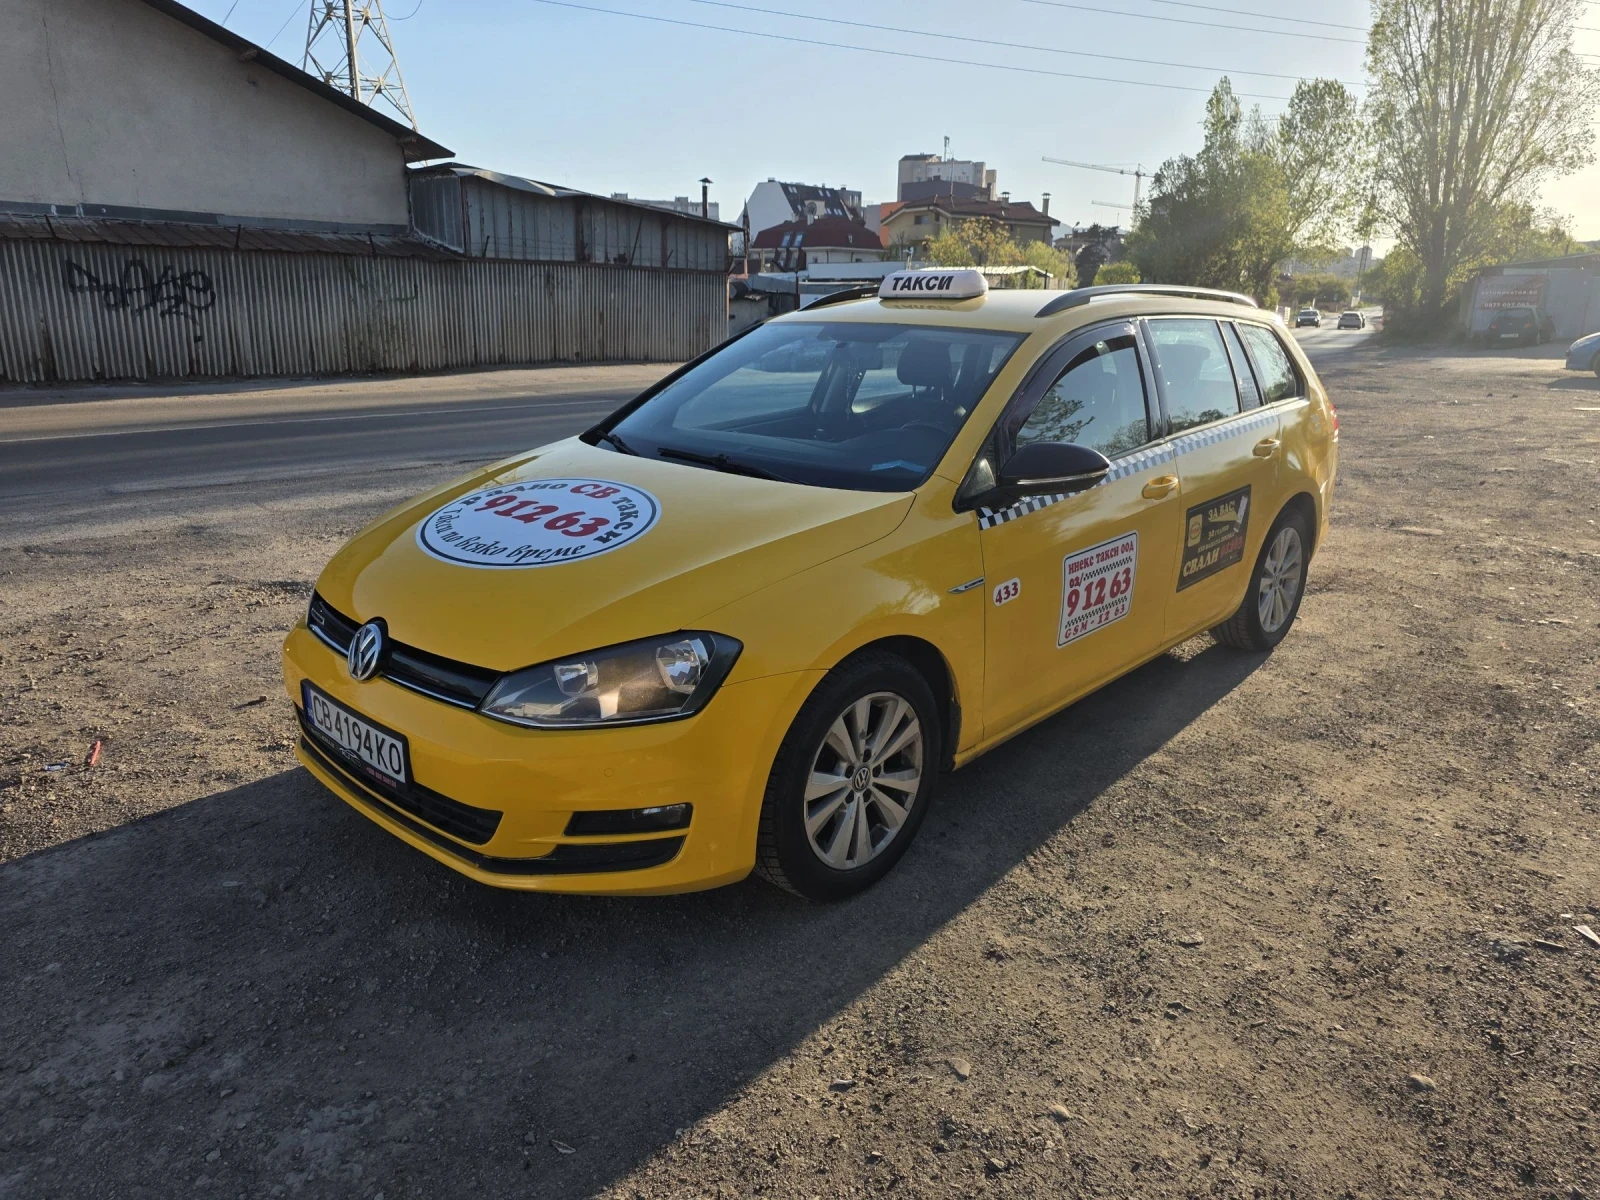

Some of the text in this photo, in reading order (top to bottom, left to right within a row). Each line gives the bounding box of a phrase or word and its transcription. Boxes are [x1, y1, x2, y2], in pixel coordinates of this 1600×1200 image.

[892, 275, 954, 291] ТАКСИ
[442, 530, 457, 543] по
[454, 536, 508, 557] всяко
[506, 544, 586, 563] време
[995, 581, 1019, 604] 433
